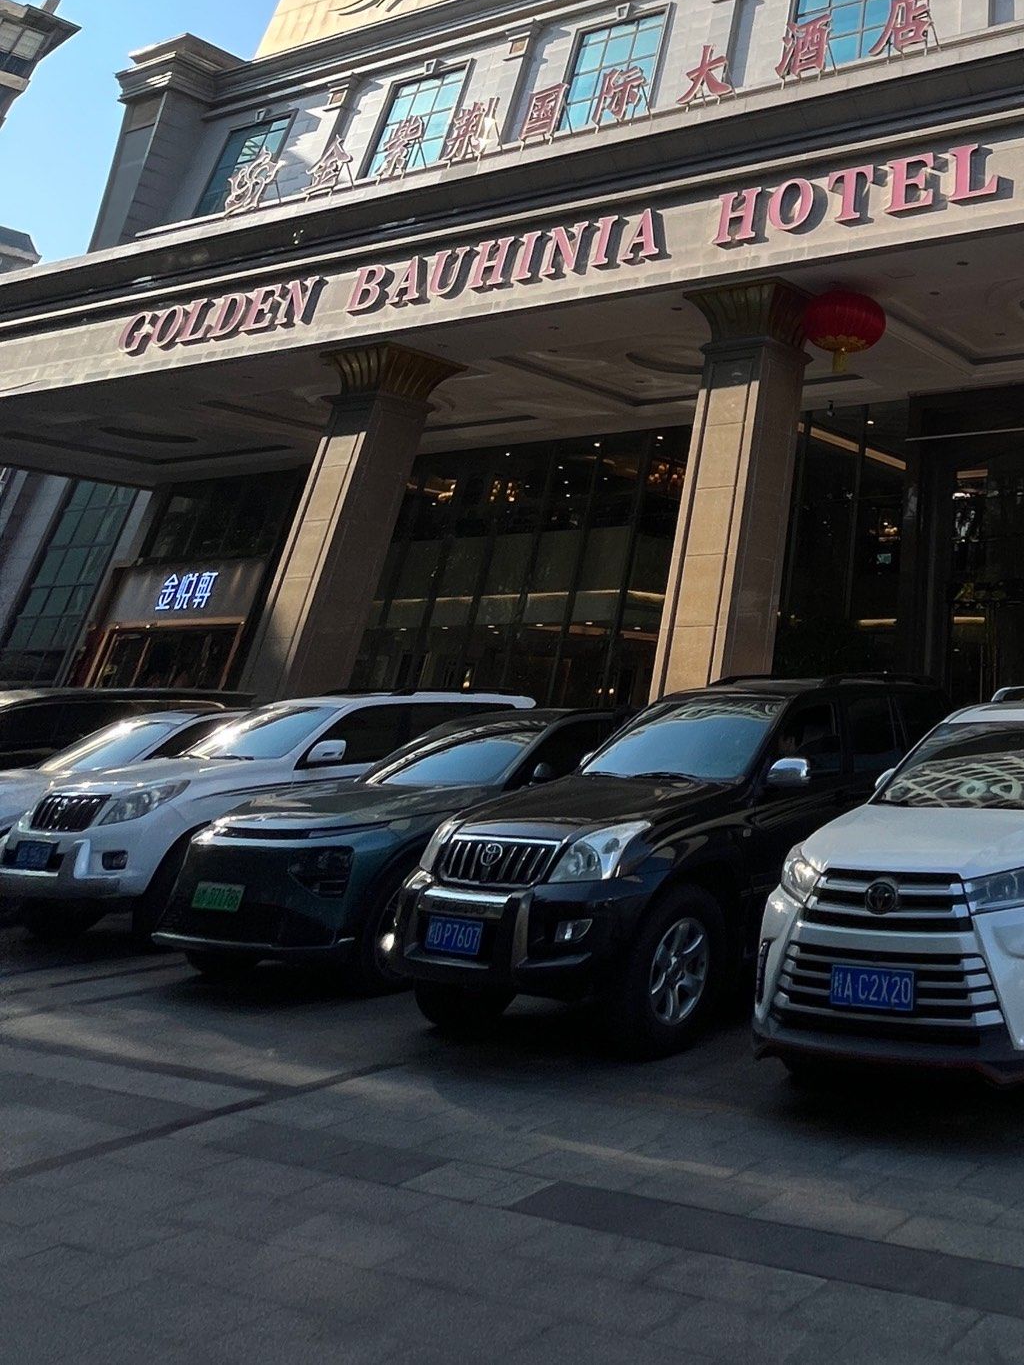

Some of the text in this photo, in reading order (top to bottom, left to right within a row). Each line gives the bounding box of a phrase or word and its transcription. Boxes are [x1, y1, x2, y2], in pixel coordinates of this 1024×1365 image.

[118, 143, 999, 353] GOLDEN BAUHINIA HOTEL
